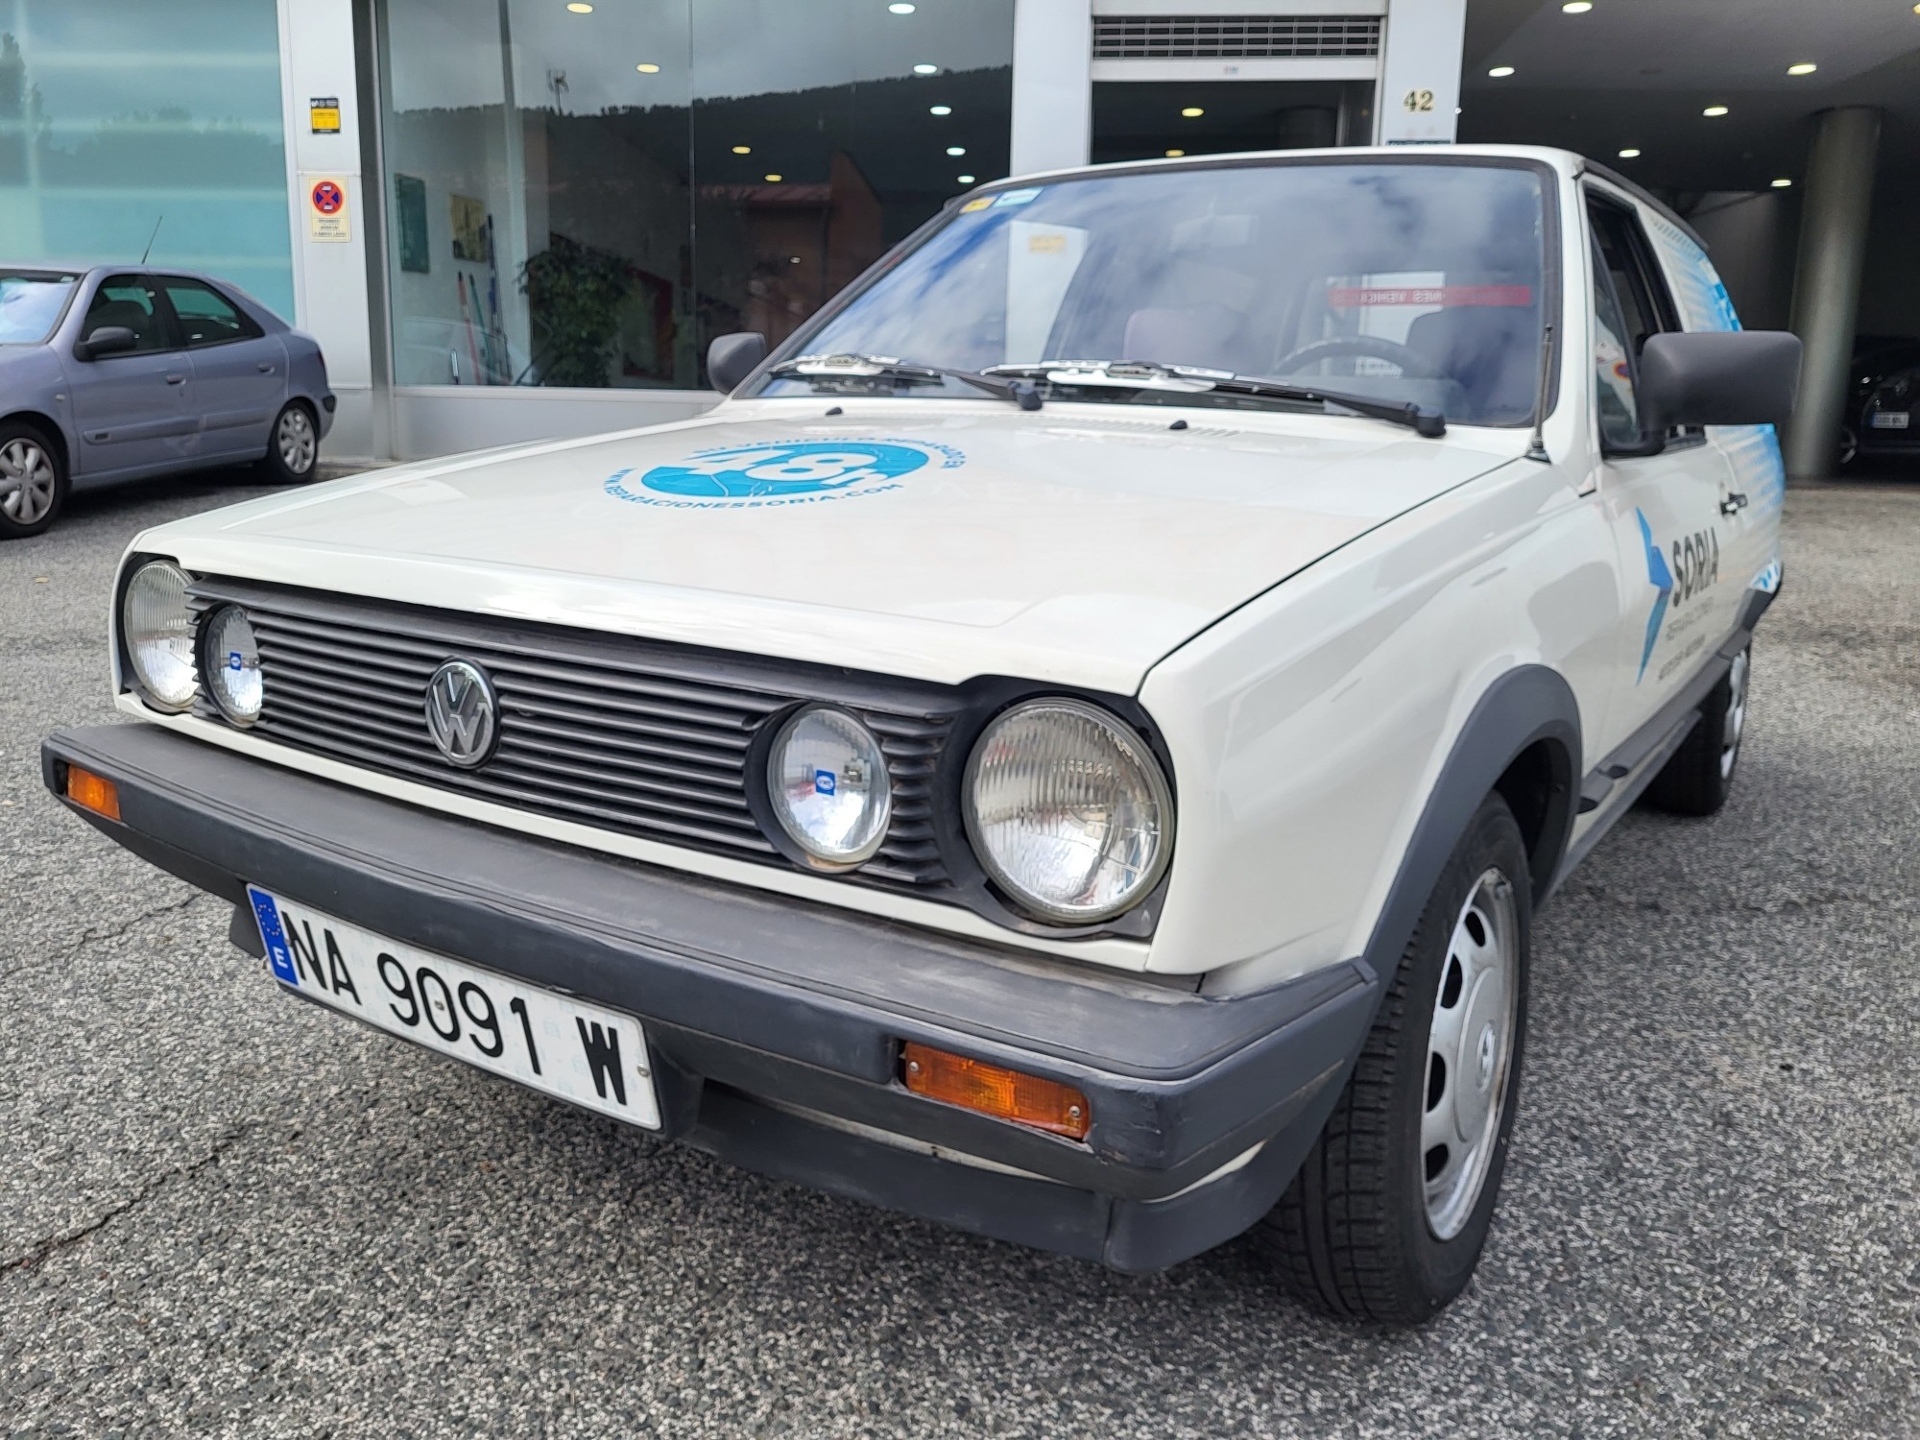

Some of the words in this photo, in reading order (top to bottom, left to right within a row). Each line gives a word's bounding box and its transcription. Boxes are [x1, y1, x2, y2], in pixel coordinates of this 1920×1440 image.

[1403, 89, 1434, 112] 42
[1672, 526, 1719, 607] SORIA
[273, 946, 288, 969] E
[281, 911, 362, 1006] NA
[377, 952, 542, 1076] 9091
[575, 1015, 628, 1106] W
